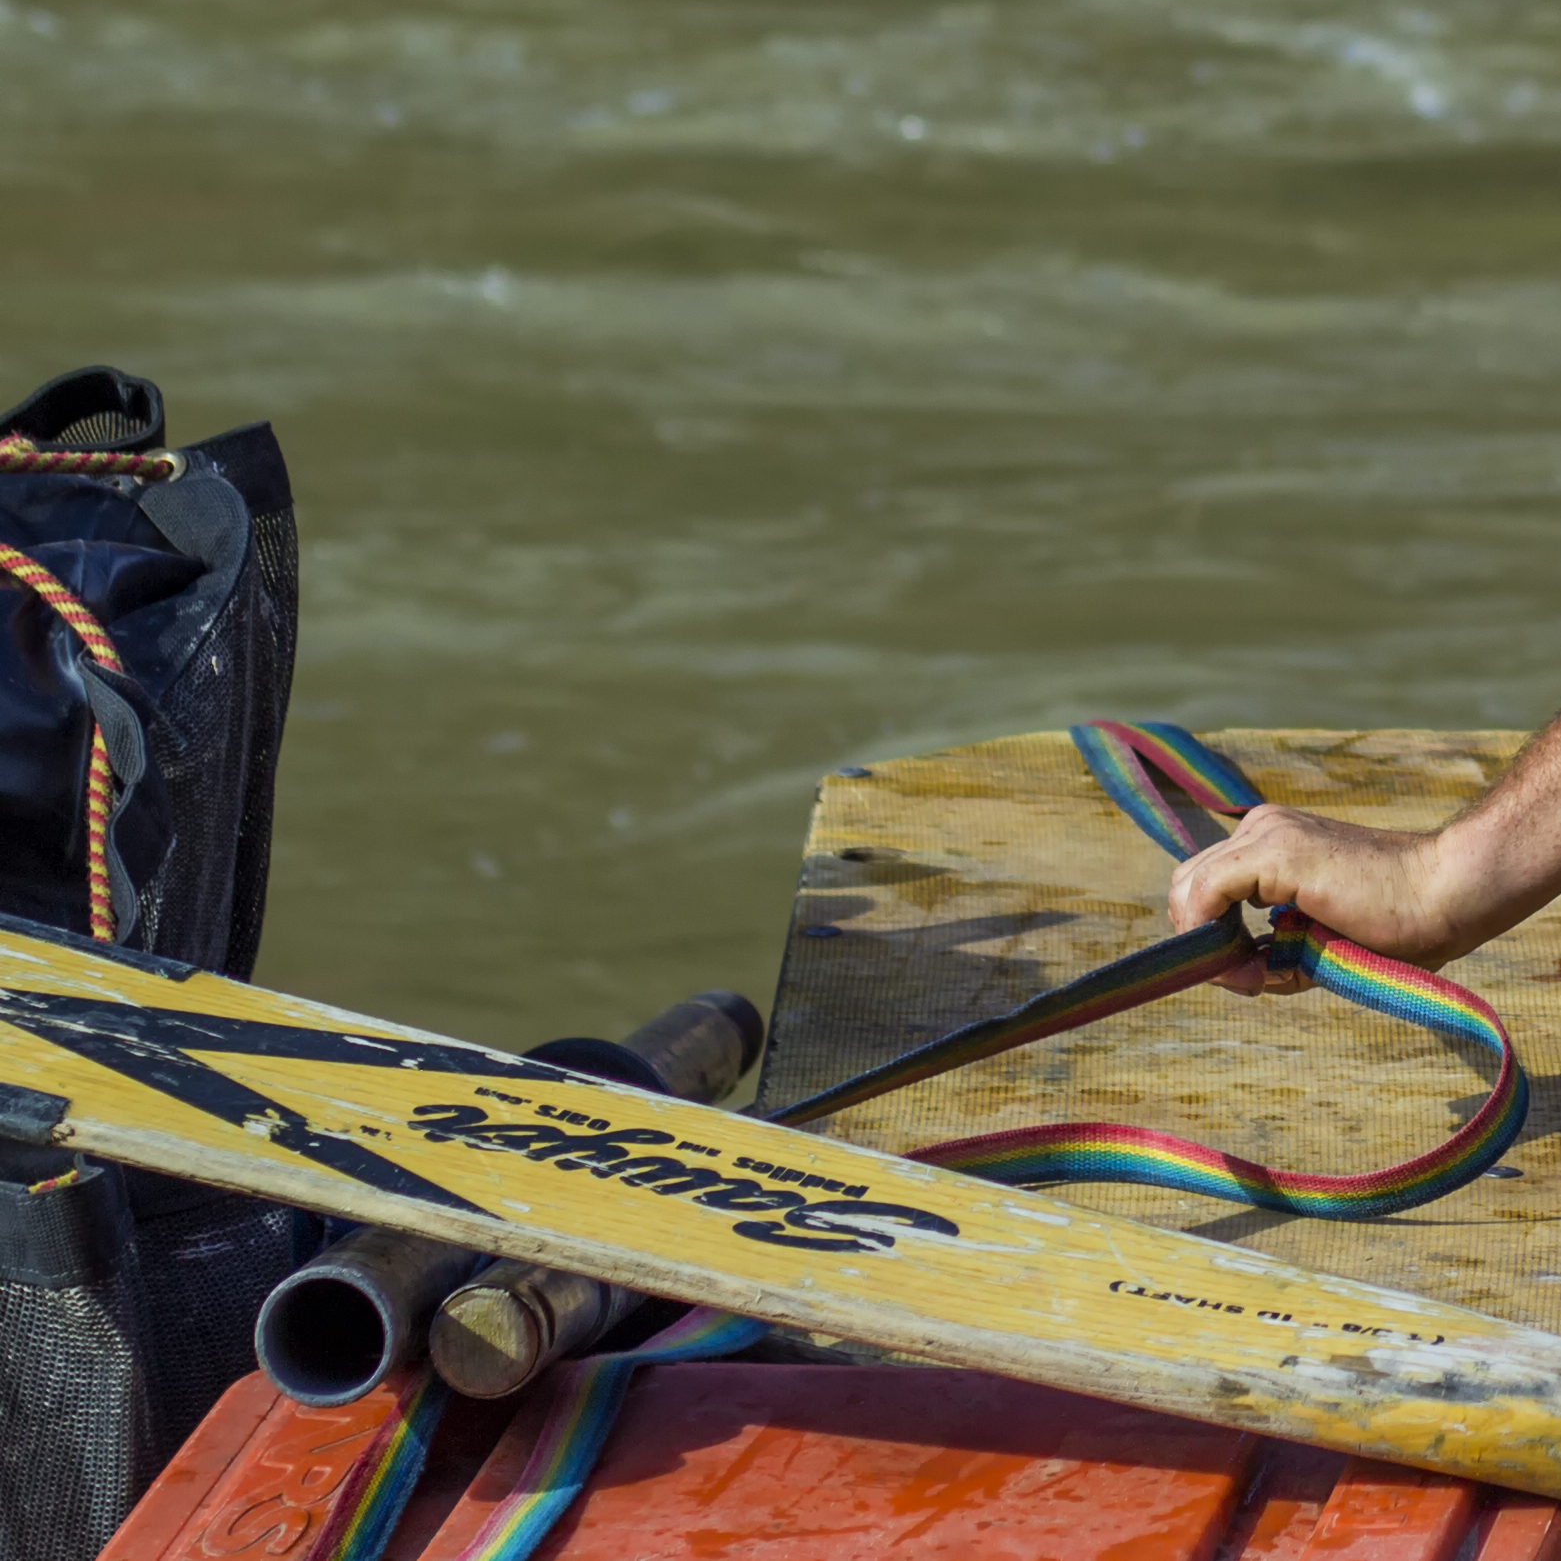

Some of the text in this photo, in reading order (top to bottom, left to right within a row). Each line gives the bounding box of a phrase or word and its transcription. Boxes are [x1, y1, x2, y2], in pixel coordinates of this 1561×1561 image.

[533, 1104, 612, 1131] oars
[675, 1140, 722, 1157] and
[406, 1103, 960, 1253] Sawyer
[732, 1156, 870, 1199] paddles
